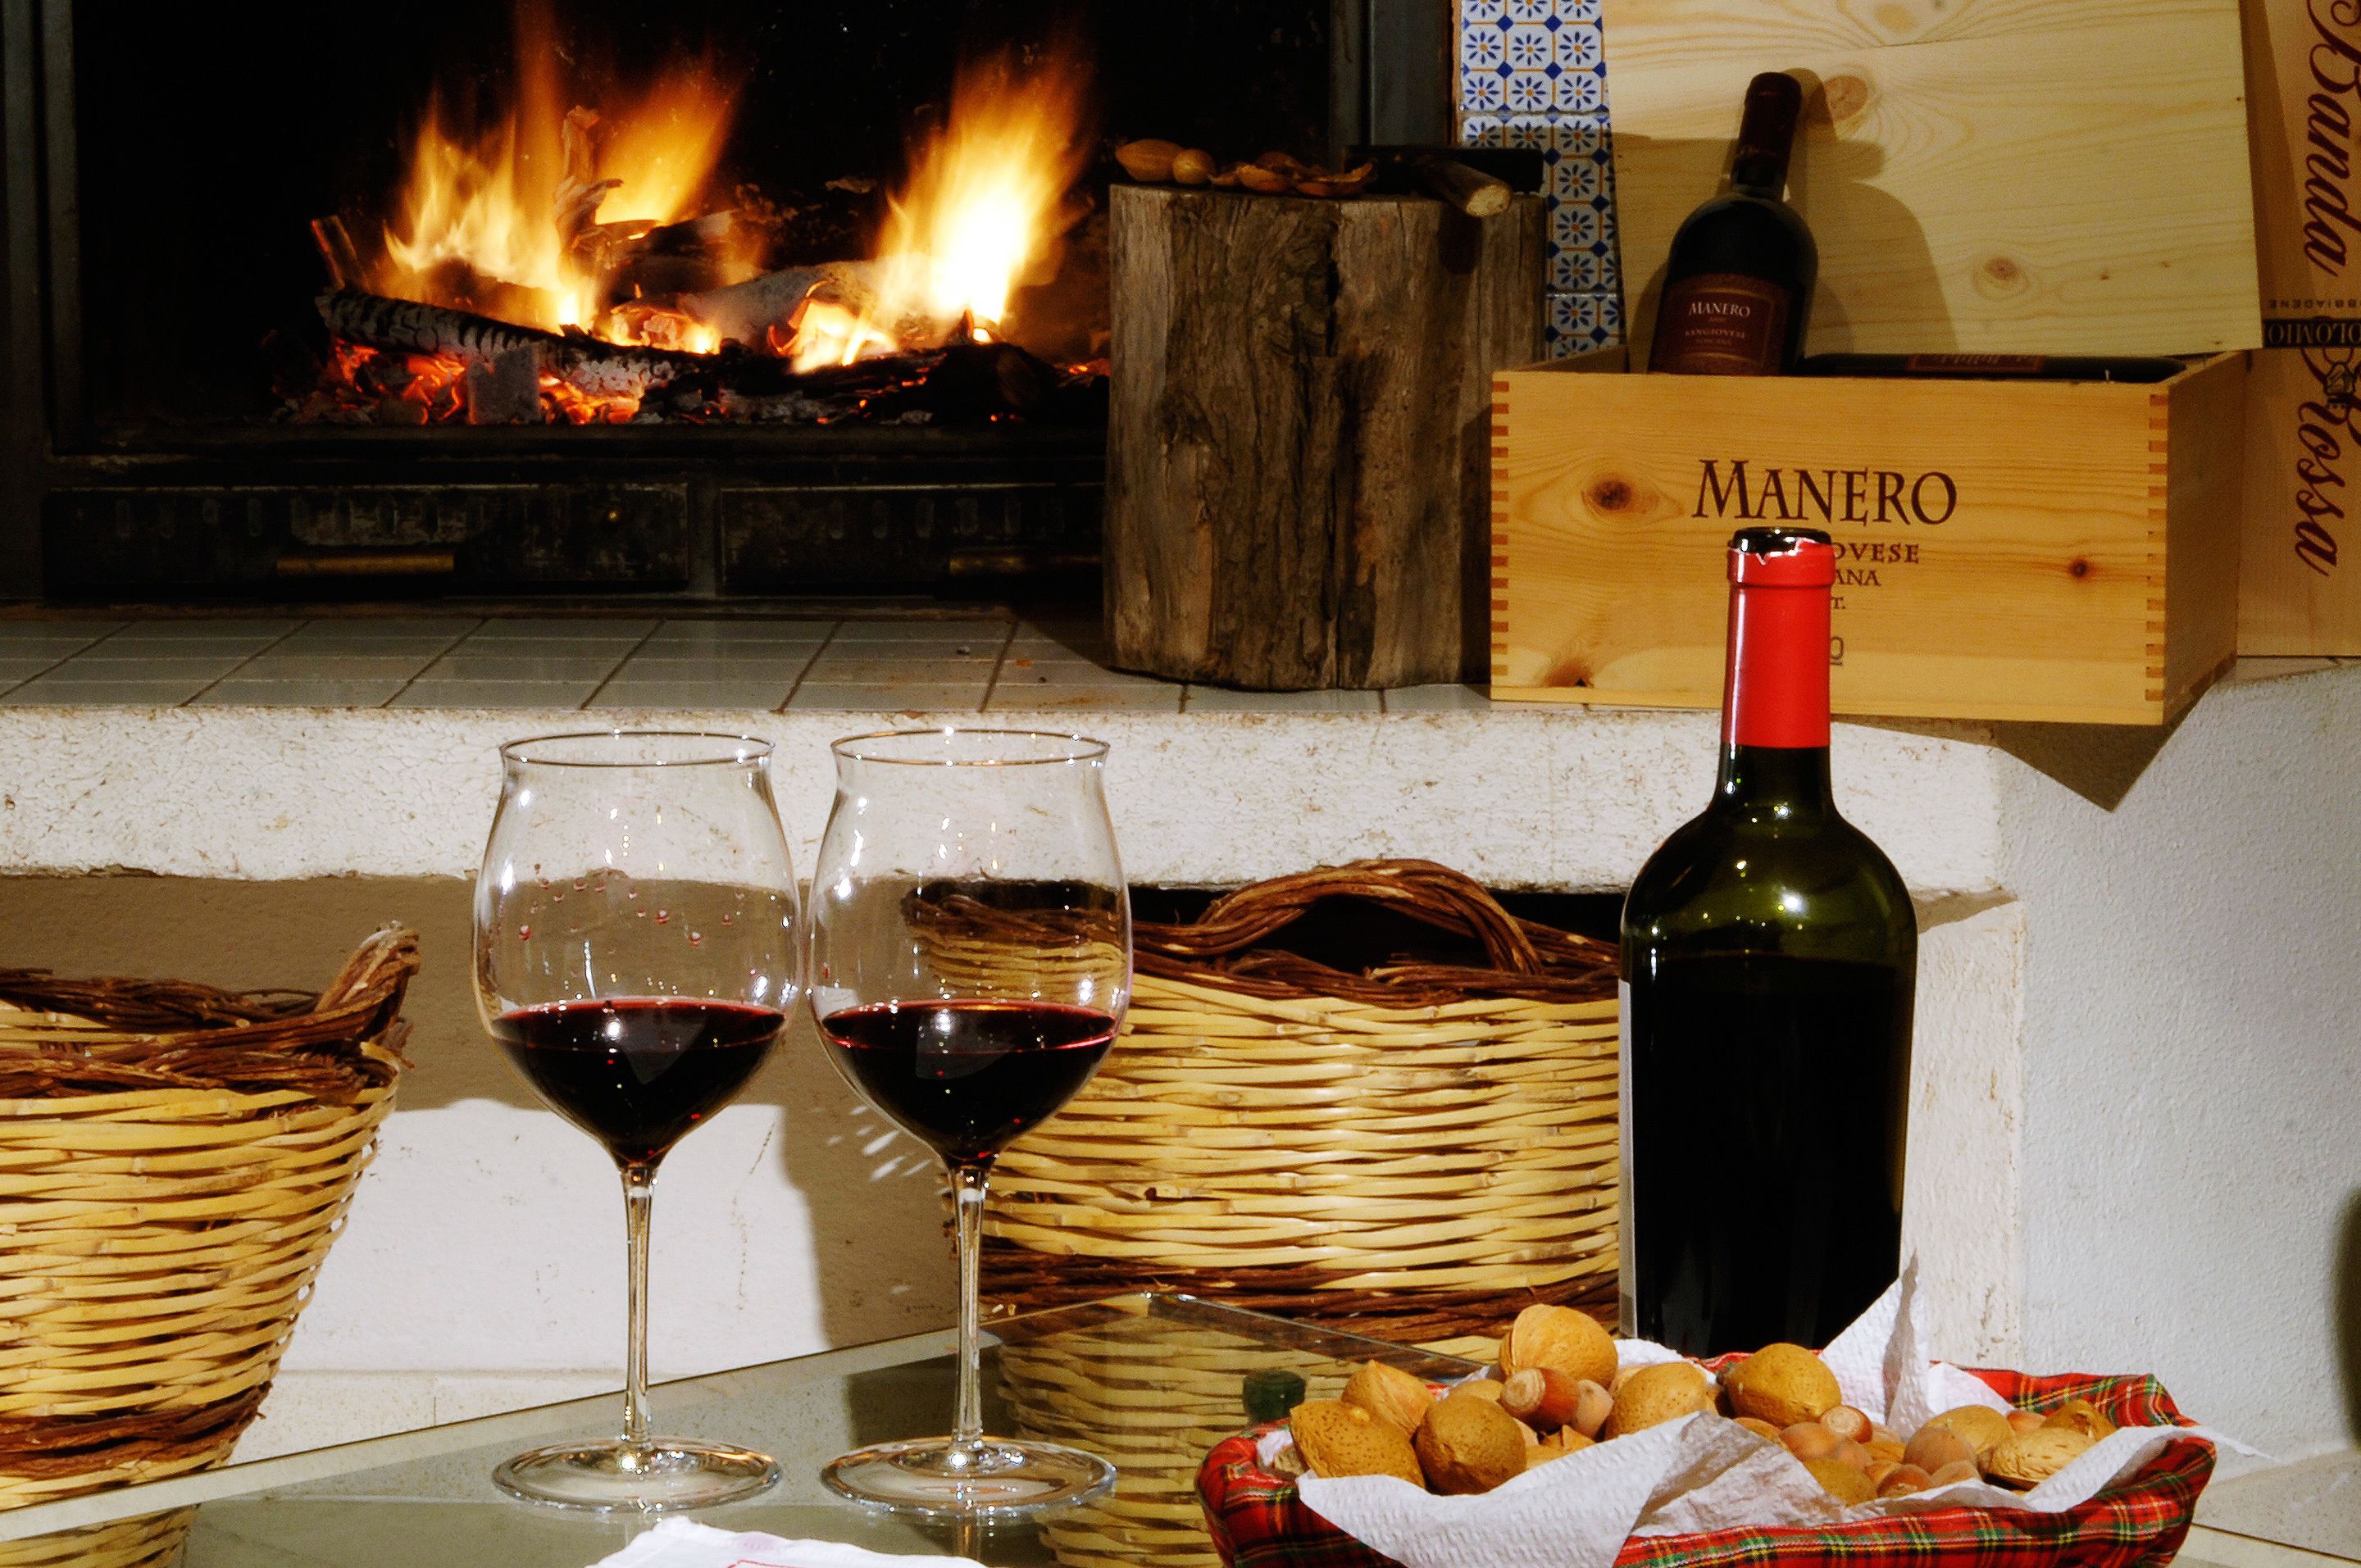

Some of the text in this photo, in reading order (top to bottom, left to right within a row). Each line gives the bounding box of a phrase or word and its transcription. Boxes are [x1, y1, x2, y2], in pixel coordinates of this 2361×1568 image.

[1689, 301, 1751, 316] MANERO
[2266, 322, 2361, 344] OLOMIO
[1690, 459, 1958, 526] MANERO
[1831, 541, 1920, 565] OVESE
